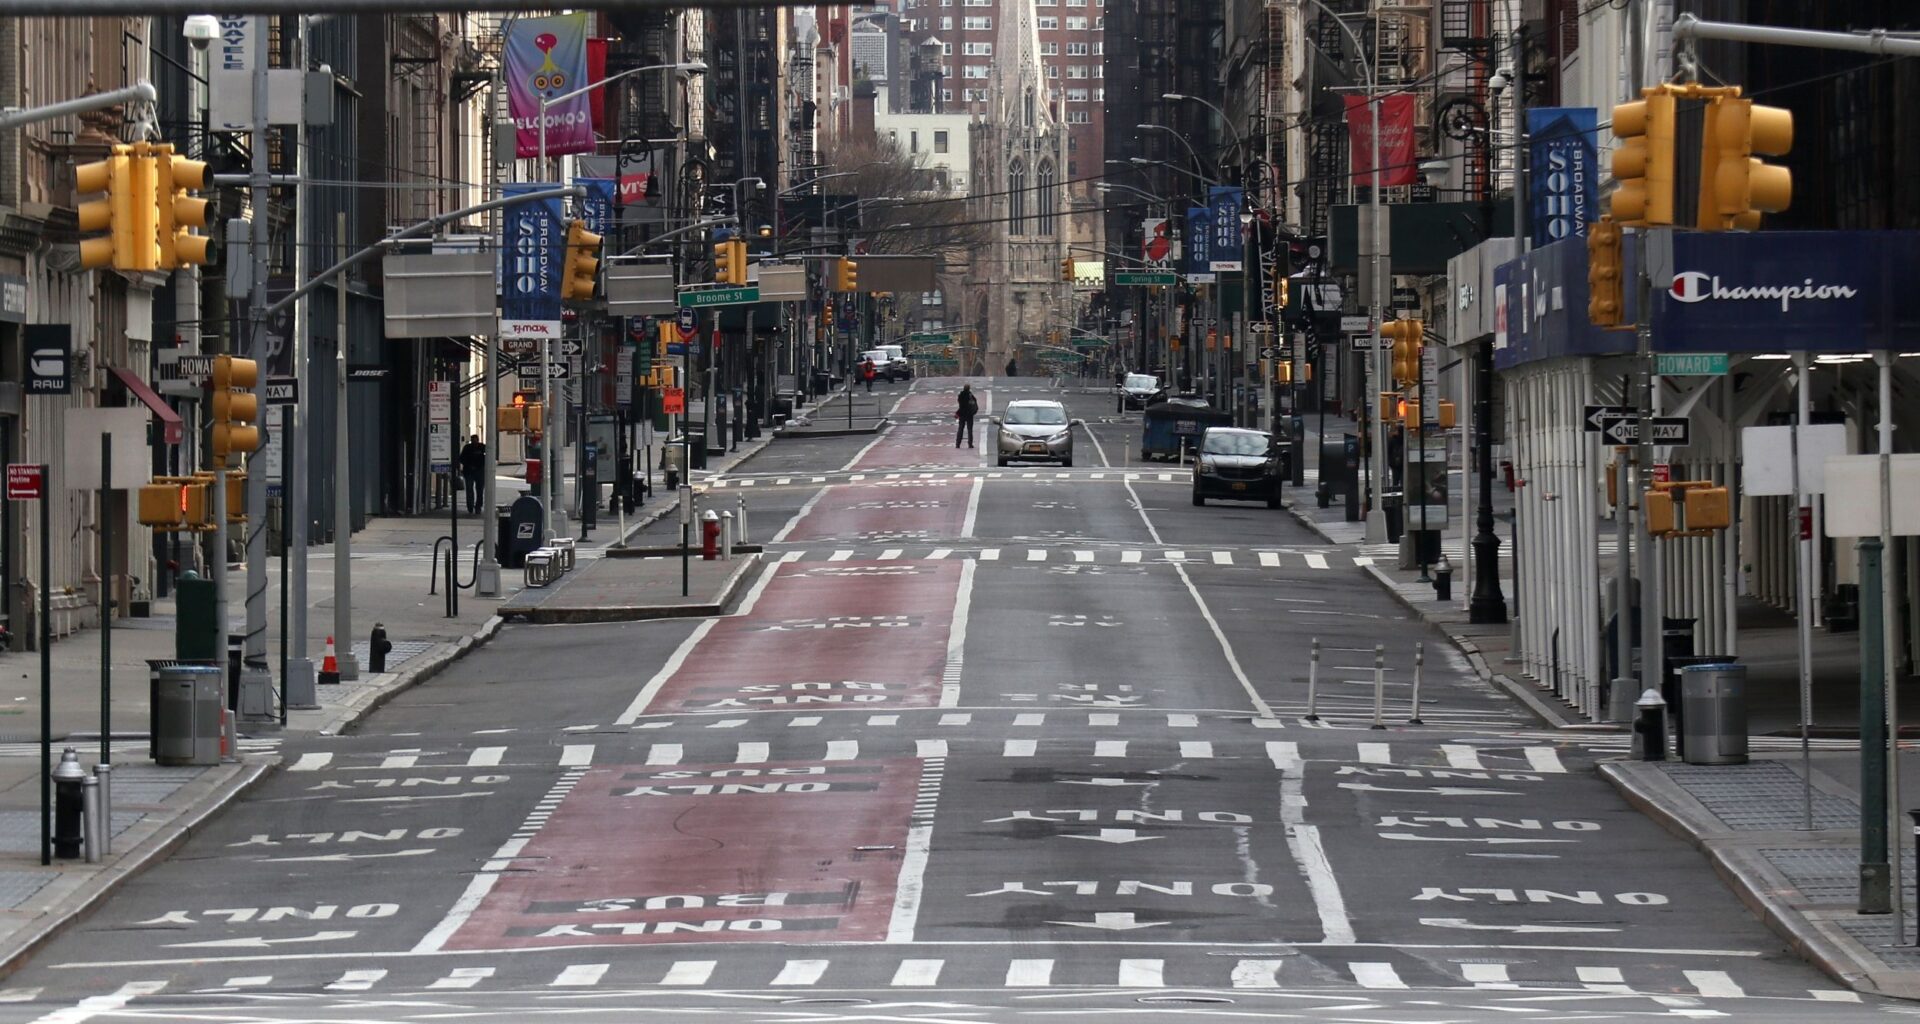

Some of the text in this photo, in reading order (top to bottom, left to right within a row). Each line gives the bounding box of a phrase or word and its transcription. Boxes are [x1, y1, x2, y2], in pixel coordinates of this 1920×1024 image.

[1573, 150, 1585, 238] BROADWAY
[540, 218, 549, 294] BROADWAY
[1131, 275, 1152, 284] Spring
[696, 292, 743, 303] Broome St
[1669, 271, 1857, 312] Champion
[508, 341, 533, 349] GRAND
[524, 367, 541, 375] ONE
[1658, 356, 1724, 373] HOWARD ST
[33, 380, 64, 389] RAW
[1615, 426, 1679, 438] ONE WAY
[738, 680, 886, 694] BUS
[705, 694, 890, 708] ONLY
[649, 766, 826, 780] BUS
[1334, 766, 1545, 781] ONLY
[305, 775, 511, 791] ONLY
[623, 782, 831, 796] ONLY
[983, 809, 1254, 824] ONLY
[1375, 815, 1603, 832] ONLY
[226, 827, 465, 848] ONLY
[966, 881, 1275, 897] ONLY
[1411, 886, 1671, 906] ONLY
[577, 892, 790, 913] BUS
[133, 903, 400, 925] ONLY
[536, 918, 783, 938] ONLY
